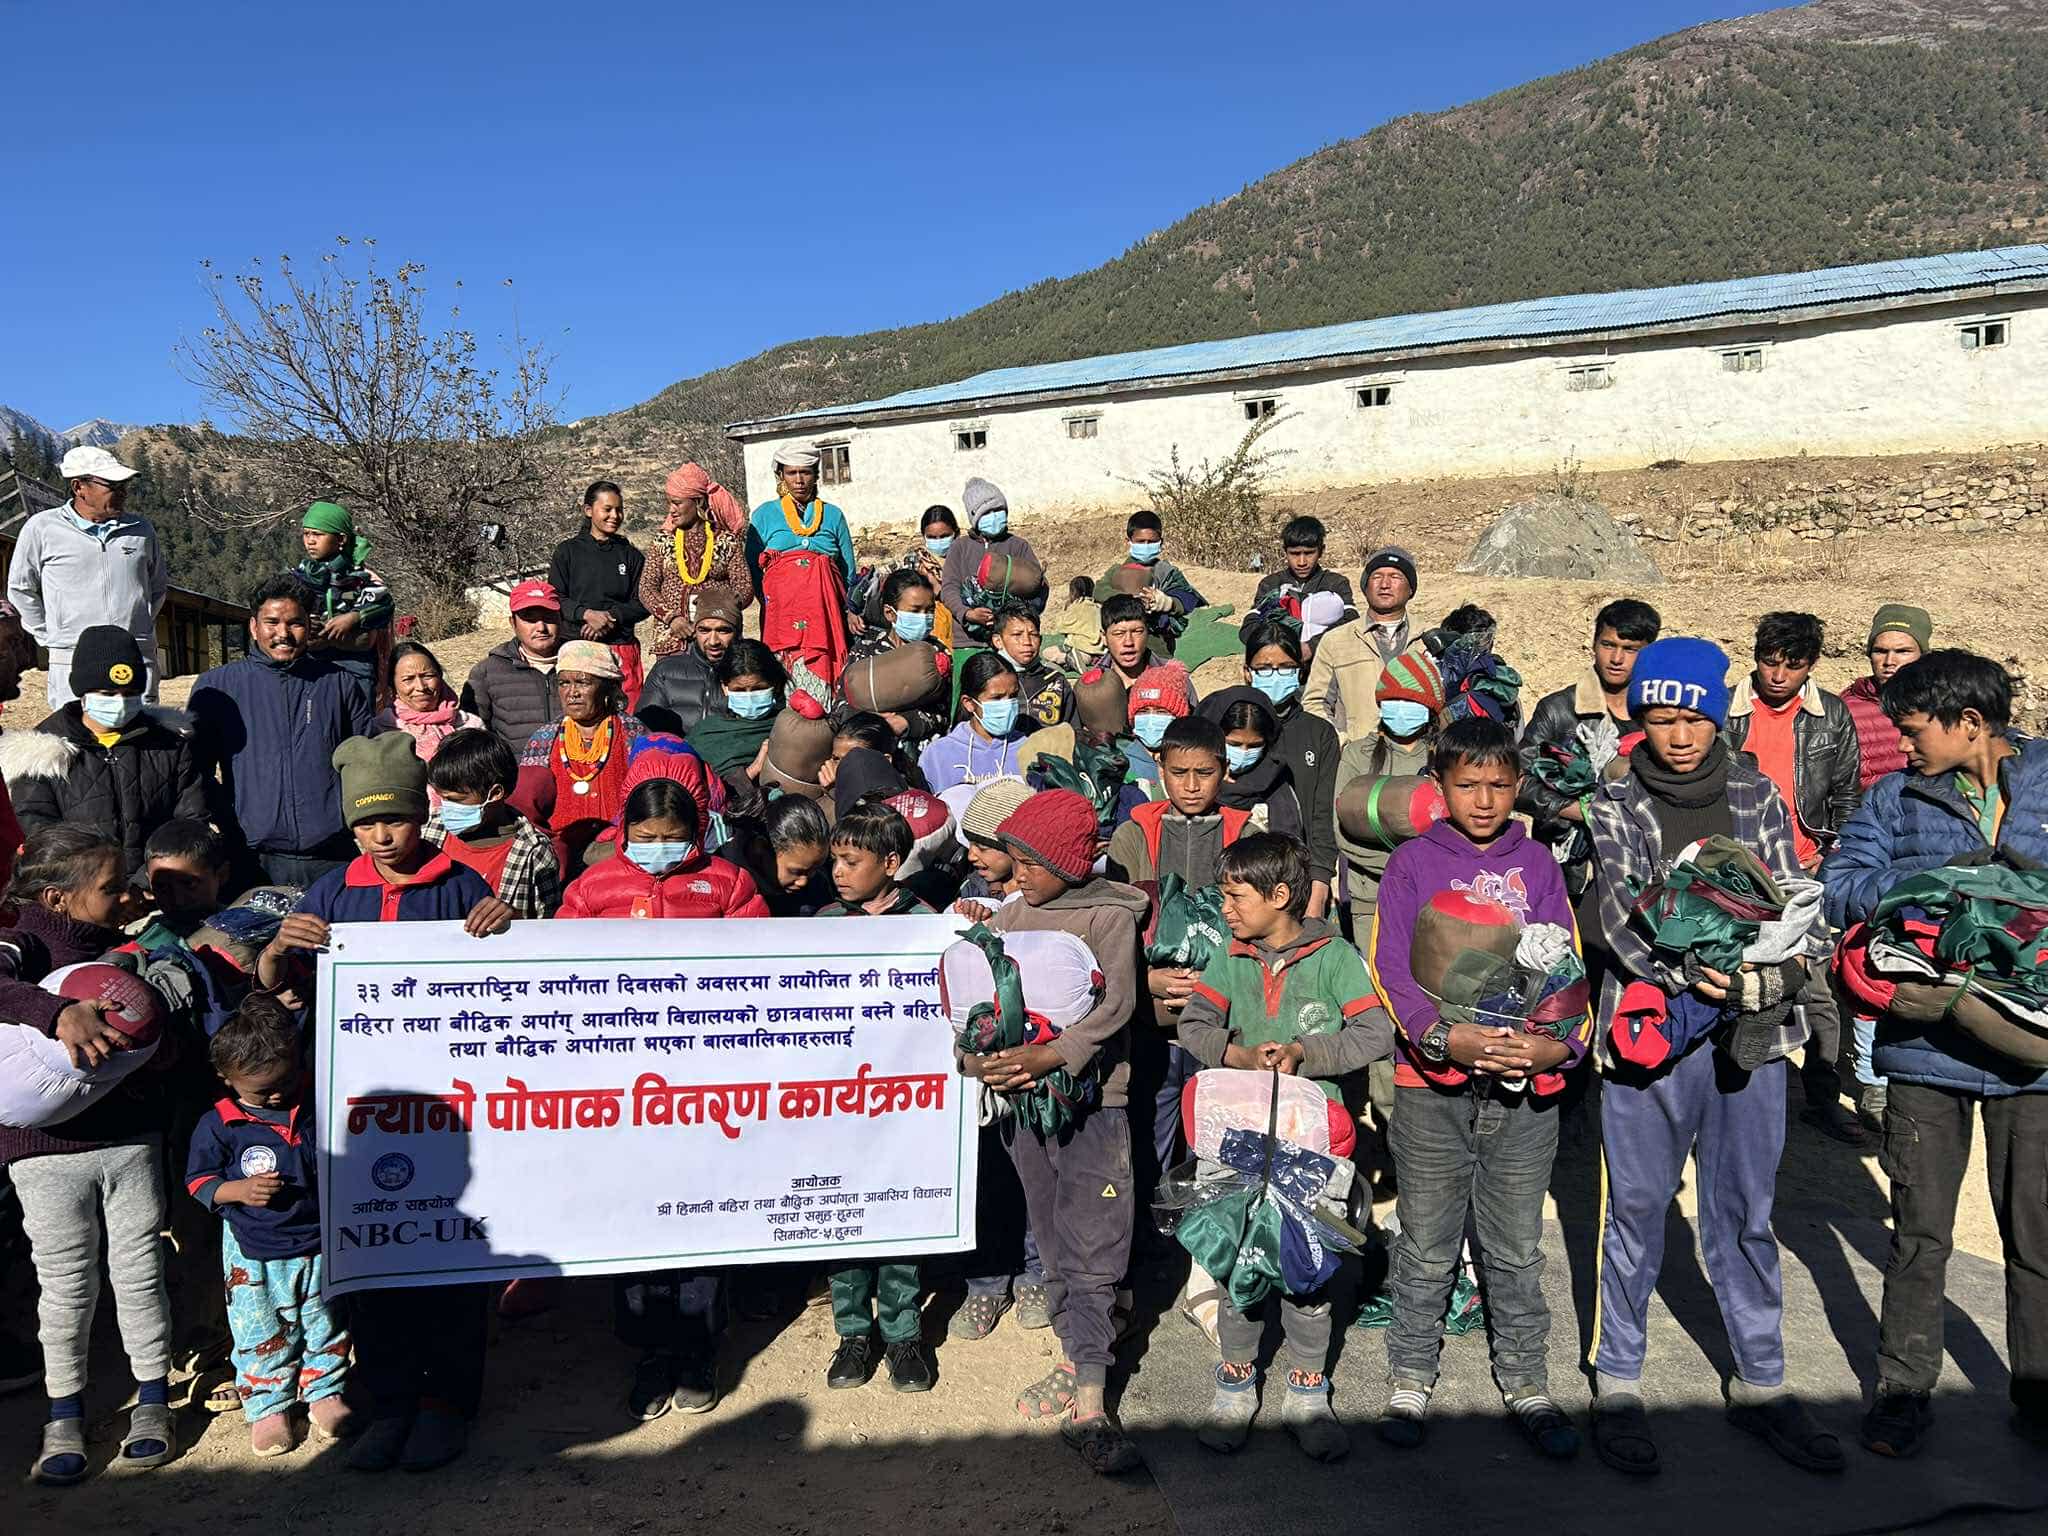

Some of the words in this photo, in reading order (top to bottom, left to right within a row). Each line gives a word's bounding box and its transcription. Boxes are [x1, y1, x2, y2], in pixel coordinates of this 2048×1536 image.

[1642, 680, 1707, 711] HOT
[357, 982, 379, 1004] ३३
[616, 973, 686, 995] दिवसको
[696, 974, 770, 993] अवसरमा
[778, 969, 851, 990] आयोजित
[859, 968, 880, 990] श्री
[340, 1013, 394, 1037] बहिरा
[403, 1017, 440, 1034] तथा
[450, 1010, 512, 1034] बौद्धिक
[582, 1007, 659, 1030] आवासिय
[667, 1004, 759, 1027] विद्यालयको
[768, 1005, 853, 1026] छात्रवासमा
[862, 1003, 895, 1021] बस्ने
[449, 1041, 487, 1059] तथा
[496, 1035, 557, 1059] बौद्धिक
[566, 1035, 635, 1056] अपांगता
[645, 1035, 694, 1055] भएका
[347, 1076, 476, 1136] न्यानो
[486, 1075, 624, 1132] पोषाक
[632, 1072, 771, 1140] वितरण
[778, 1063, 948, 1120] कार्यक्रम
[791, 1173, 842, 1190] आयोजक
[352, 1198, 399, 1215] आर्थिक
[405, 1195, 456, 1212] सहयोग
[337, 1216, 489, 1252] NBC-UK
